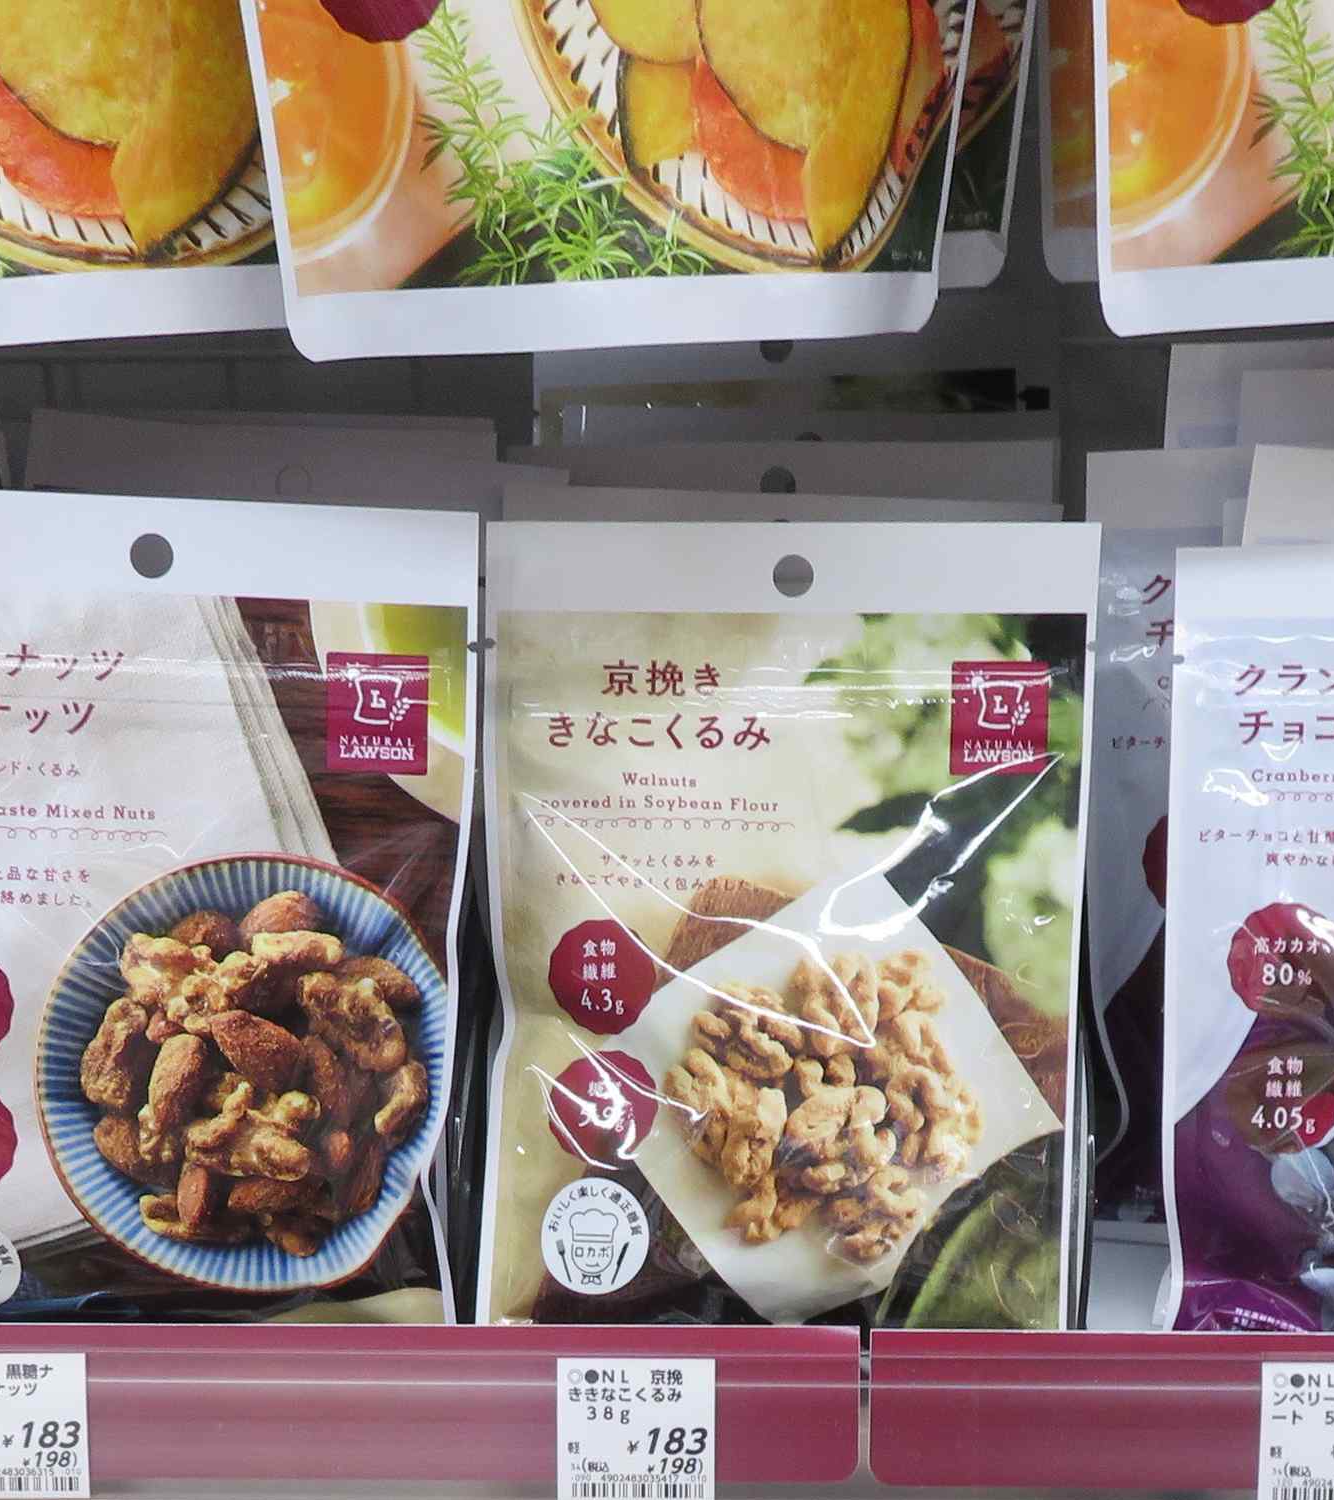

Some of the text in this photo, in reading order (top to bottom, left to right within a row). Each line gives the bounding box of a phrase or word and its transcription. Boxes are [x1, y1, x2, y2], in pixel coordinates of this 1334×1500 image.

[602, 659, 723, 698] 京挽き
[339, 734, 415, 747] NATURAL
[547, 712, 772, 750] きなこくるみ
[339, 745, 415, 761] LAWSON
[621, 772, 698, 788] Walnuts
[45, 802, 105, 819] Mixed
[113, 805, 156, 821] Nuts
[644, 795, 779, 814] Soybean Flour
[582, 940, 617, 958] 食物
[581, 962, 617, 981] 繊維
[1261, 962, 1313, 989] 80%
[581, 988, 625, 1015] 4.3g
[1266, 1055, 1305, 1076] 食物
[1265, 1079, 1305, 1098] 繊維
[1250, 1104, 1316, 1135] 4.05g
[573, 1246, 613, 1259] ロカボ
[6, 1364, 53, 1379] 黒糖ナ
[651, 1370, 683, 1385] 京挽
[568, 1387, 682, 1402] ききなこくるみ
[587, 1406, 630, 1424] 38g
